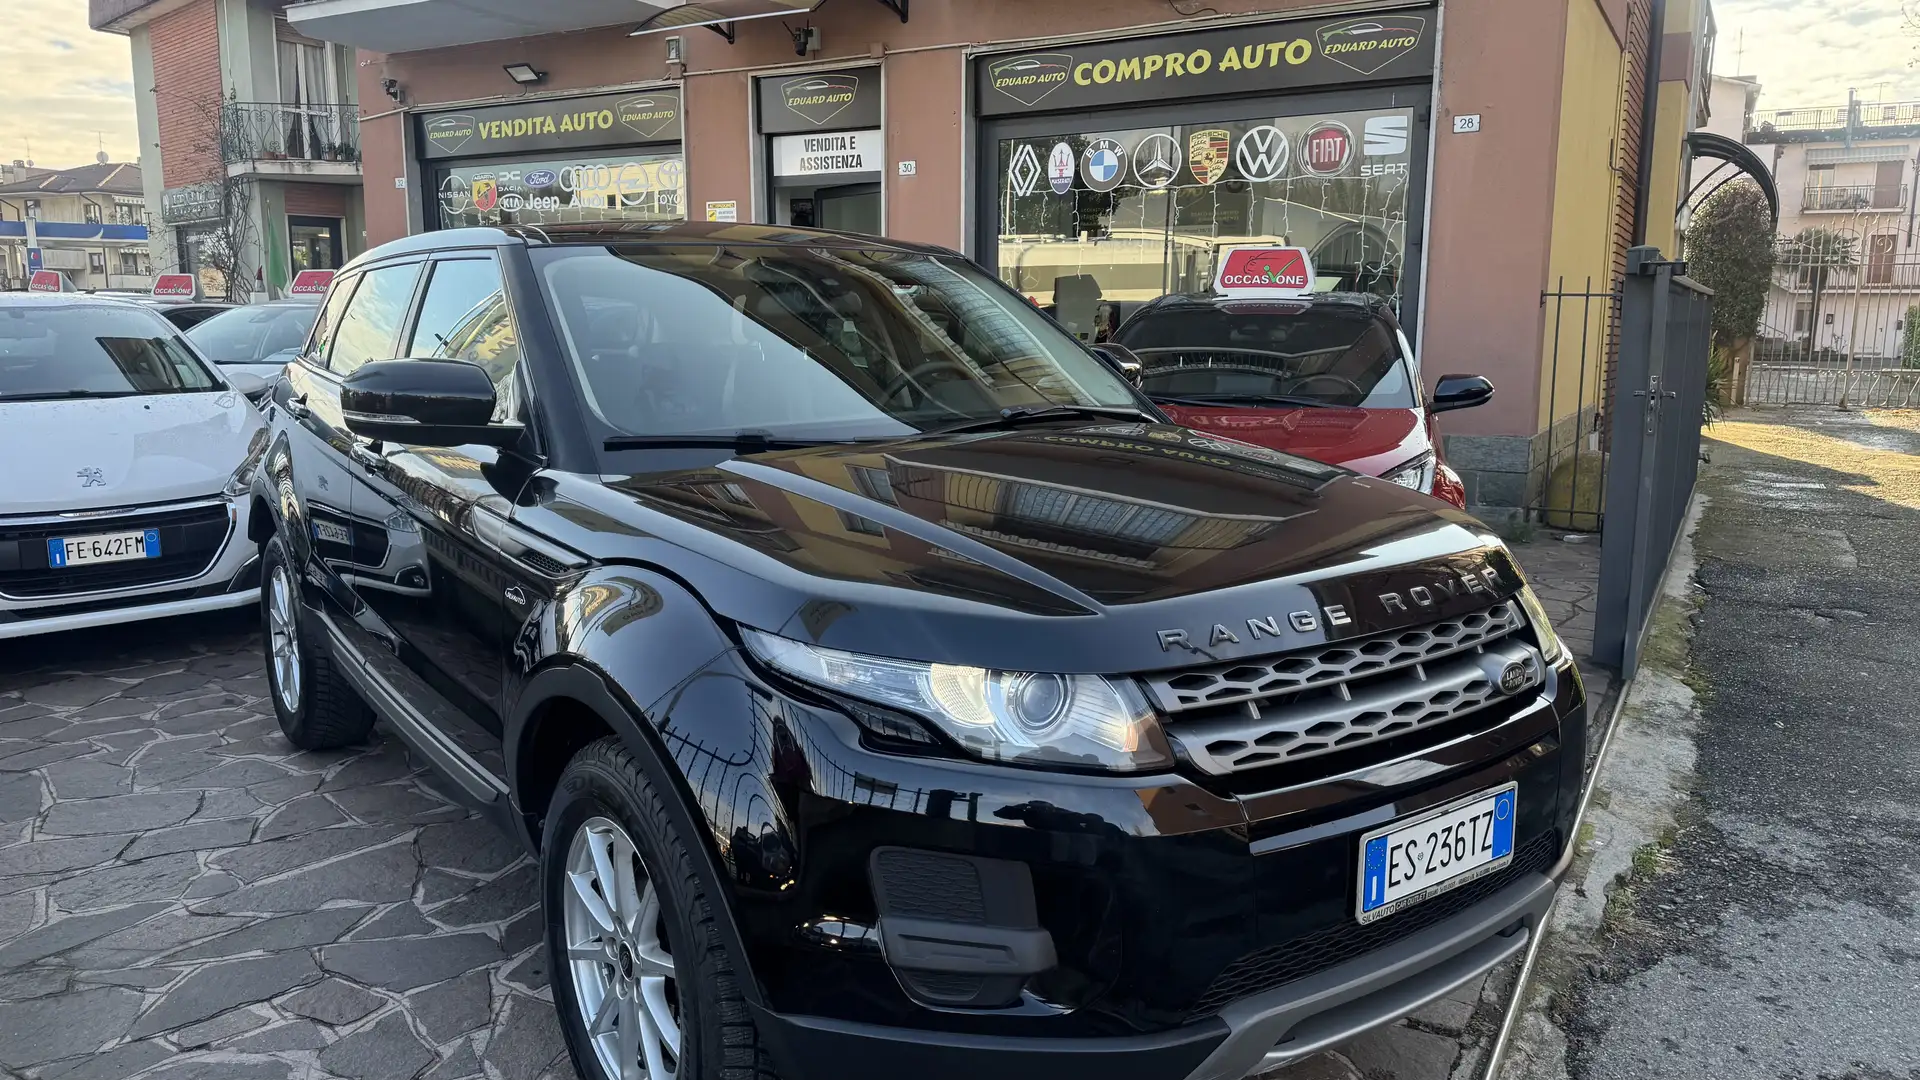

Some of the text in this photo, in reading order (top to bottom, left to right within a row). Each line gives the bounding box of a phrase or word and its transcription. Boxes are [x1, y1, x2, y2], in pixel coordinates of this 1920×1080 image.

[1323, 36, 1415, 55] EDUARD AUTO
[1073, 38, 1312, 86] COMPRO AUTO
[996, 71, 1066, 88] EDUARD AUTO
[788, 92, 852, 106] EDUARD AUTO
[478, 109, 614, 140] VENDITA AUTO
[622, 110, 674, 122] EDUARD AUTO
[1459, 117, 1475, 129] 28
[429, 128, 472, 139] EDUARD AUTO
[803, 135, 856, 153] VENDITA E
[1086, 140, 1124, 158] BMW
[1311, 137, 1343, 164] FIAT
[799, 154, 863, 172] ASSISTENZA
[902, 163, 913, 173] 30
[1360, 163, 1408, 177] SEAT
[529, 171, 550, 185] Ford
[438, 190, 471, 199] NISSAN
[503, 197, 520, 208] KIA
[525, 193, 560, 213] Jeep
[1224, 266, 1304, 285] OCCASIONE
[1156, 565, 1501, 652] RANGE ROVER
[1361, 904, 1396, 925] SILVAUTO
